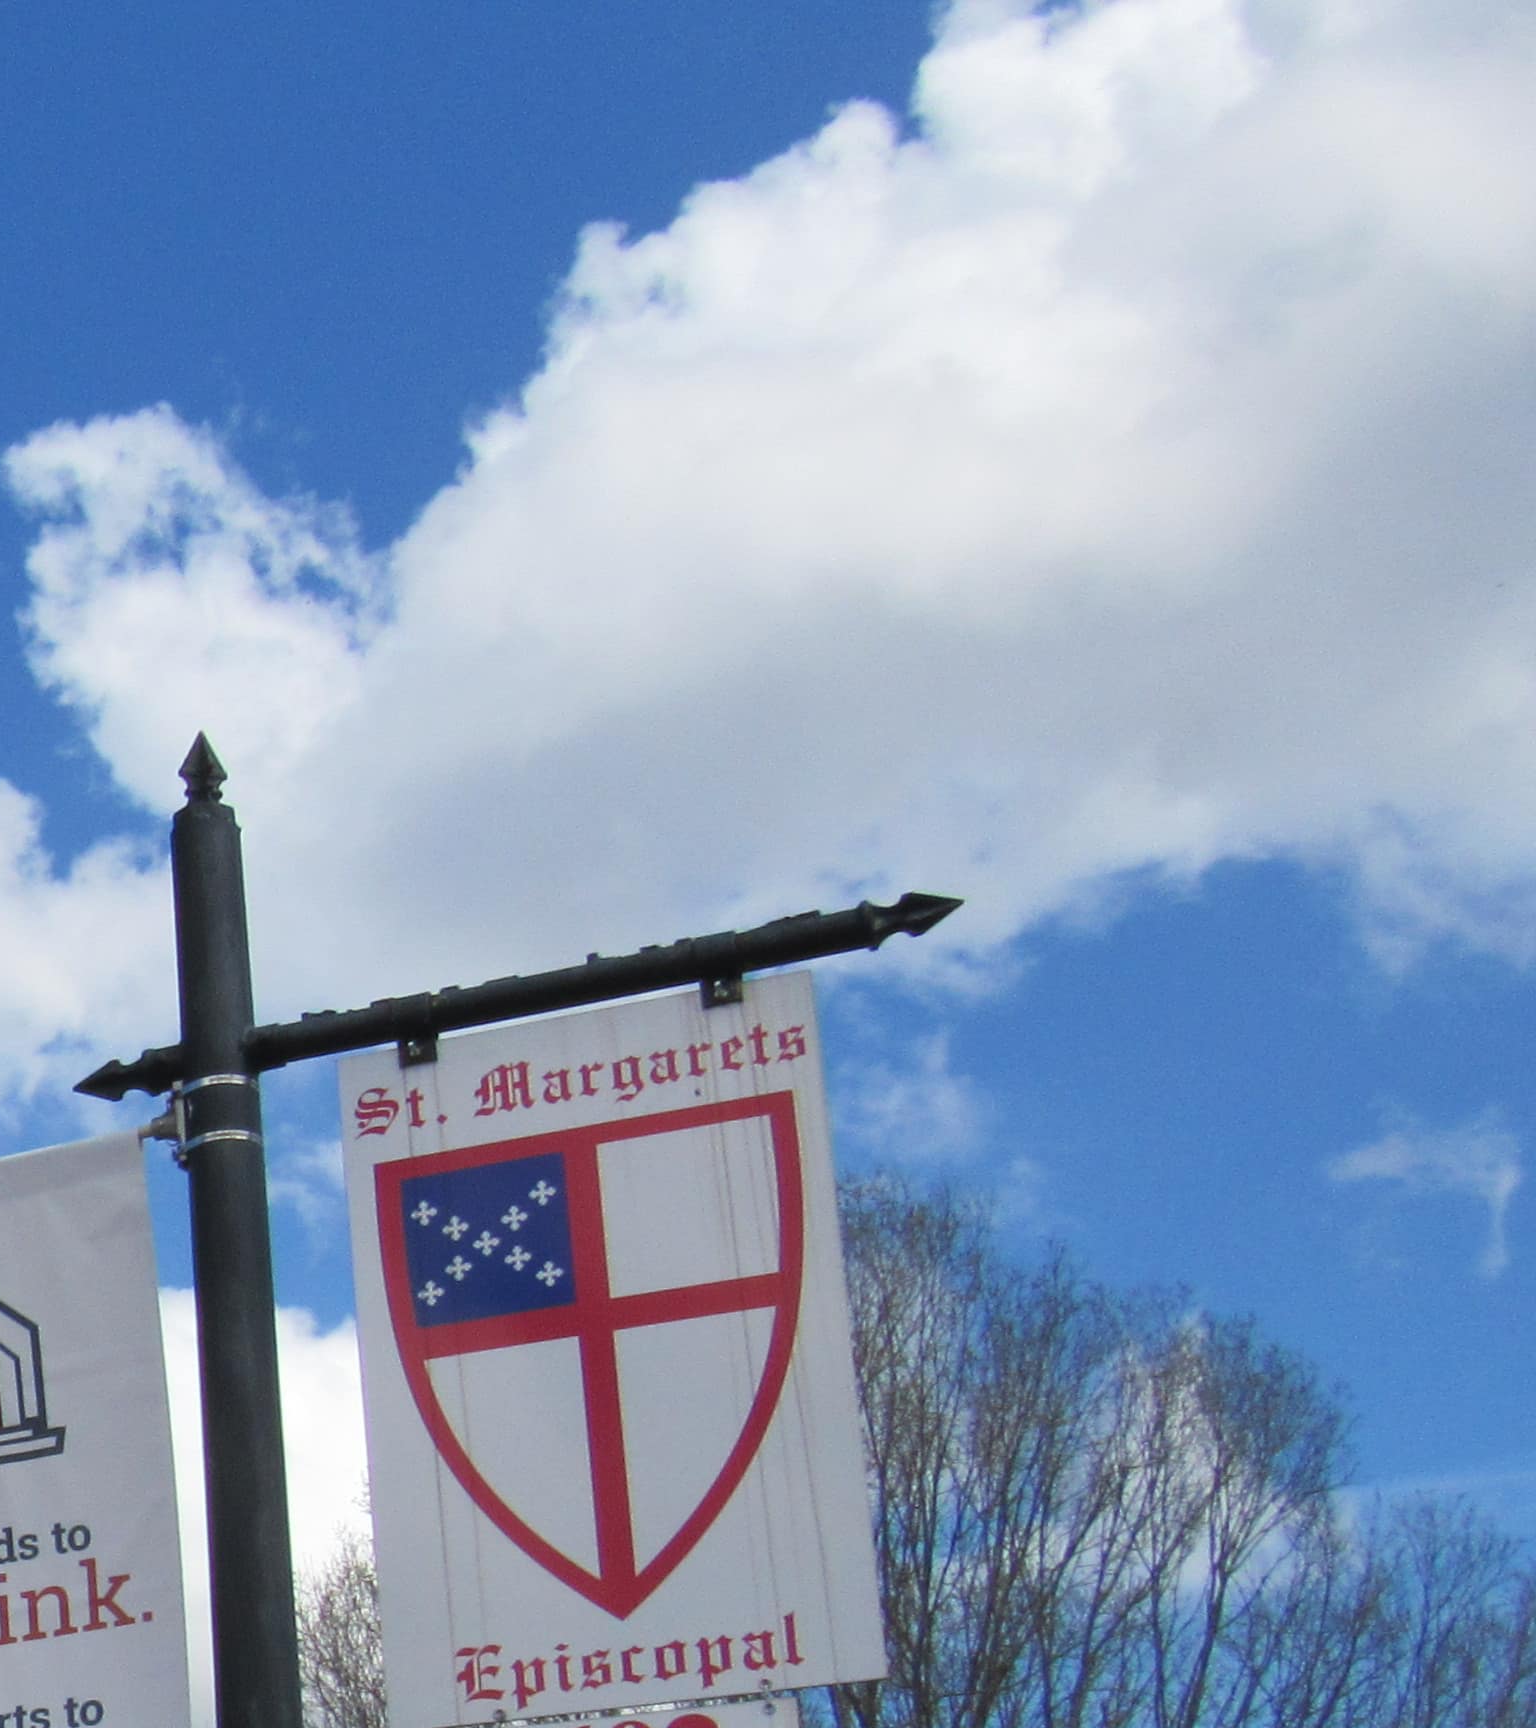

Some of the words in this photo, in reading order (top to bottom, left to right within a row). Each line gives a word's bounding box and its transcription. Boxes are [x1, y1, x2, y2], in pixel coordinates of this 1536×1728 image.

[355, 1087, 447, 1138] St.
[474, 1022, 808, 1117] Margarets
[50, 1521, 92, 1555] to
[456, 1612, 805, 1709] Episcopal
[63, 1696, 105, 1728] to
